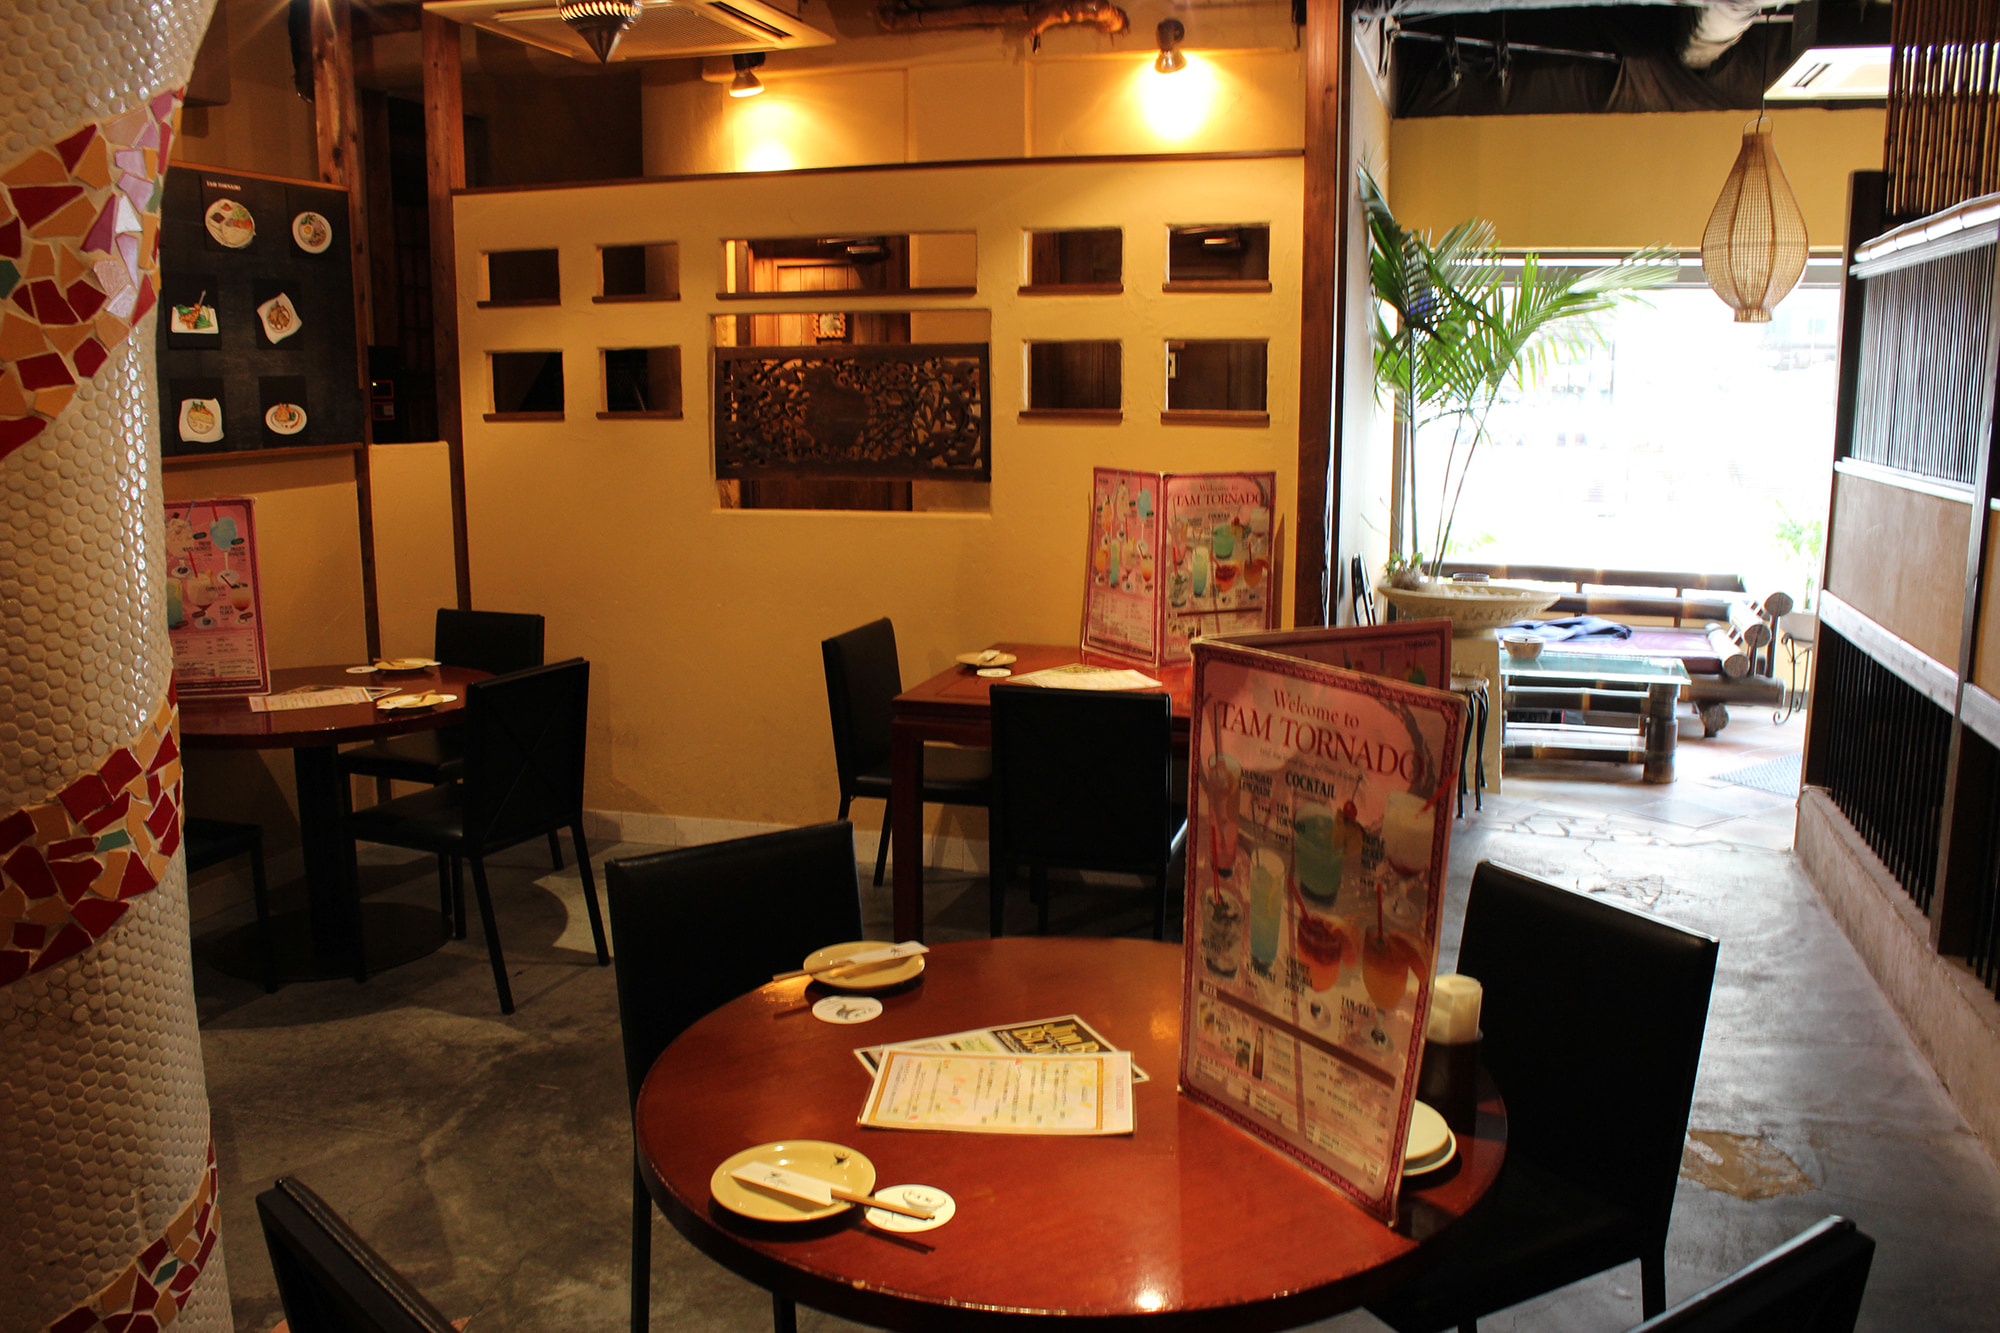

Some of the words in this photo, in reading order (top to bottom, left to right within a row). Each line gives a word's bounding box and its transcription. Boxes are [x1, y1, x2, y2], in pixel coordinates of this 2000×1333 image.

[1177, 495, 1200, 506] TAM
[1274, 688, 1339, 724] Welcome
[1345, 713, 1360, 730] to
[1217, 701, 1273, 742] TAM
[1280, 716, 1425, 782] TORNADO
[1285, 770, 1336, 800] COCKTAIL
